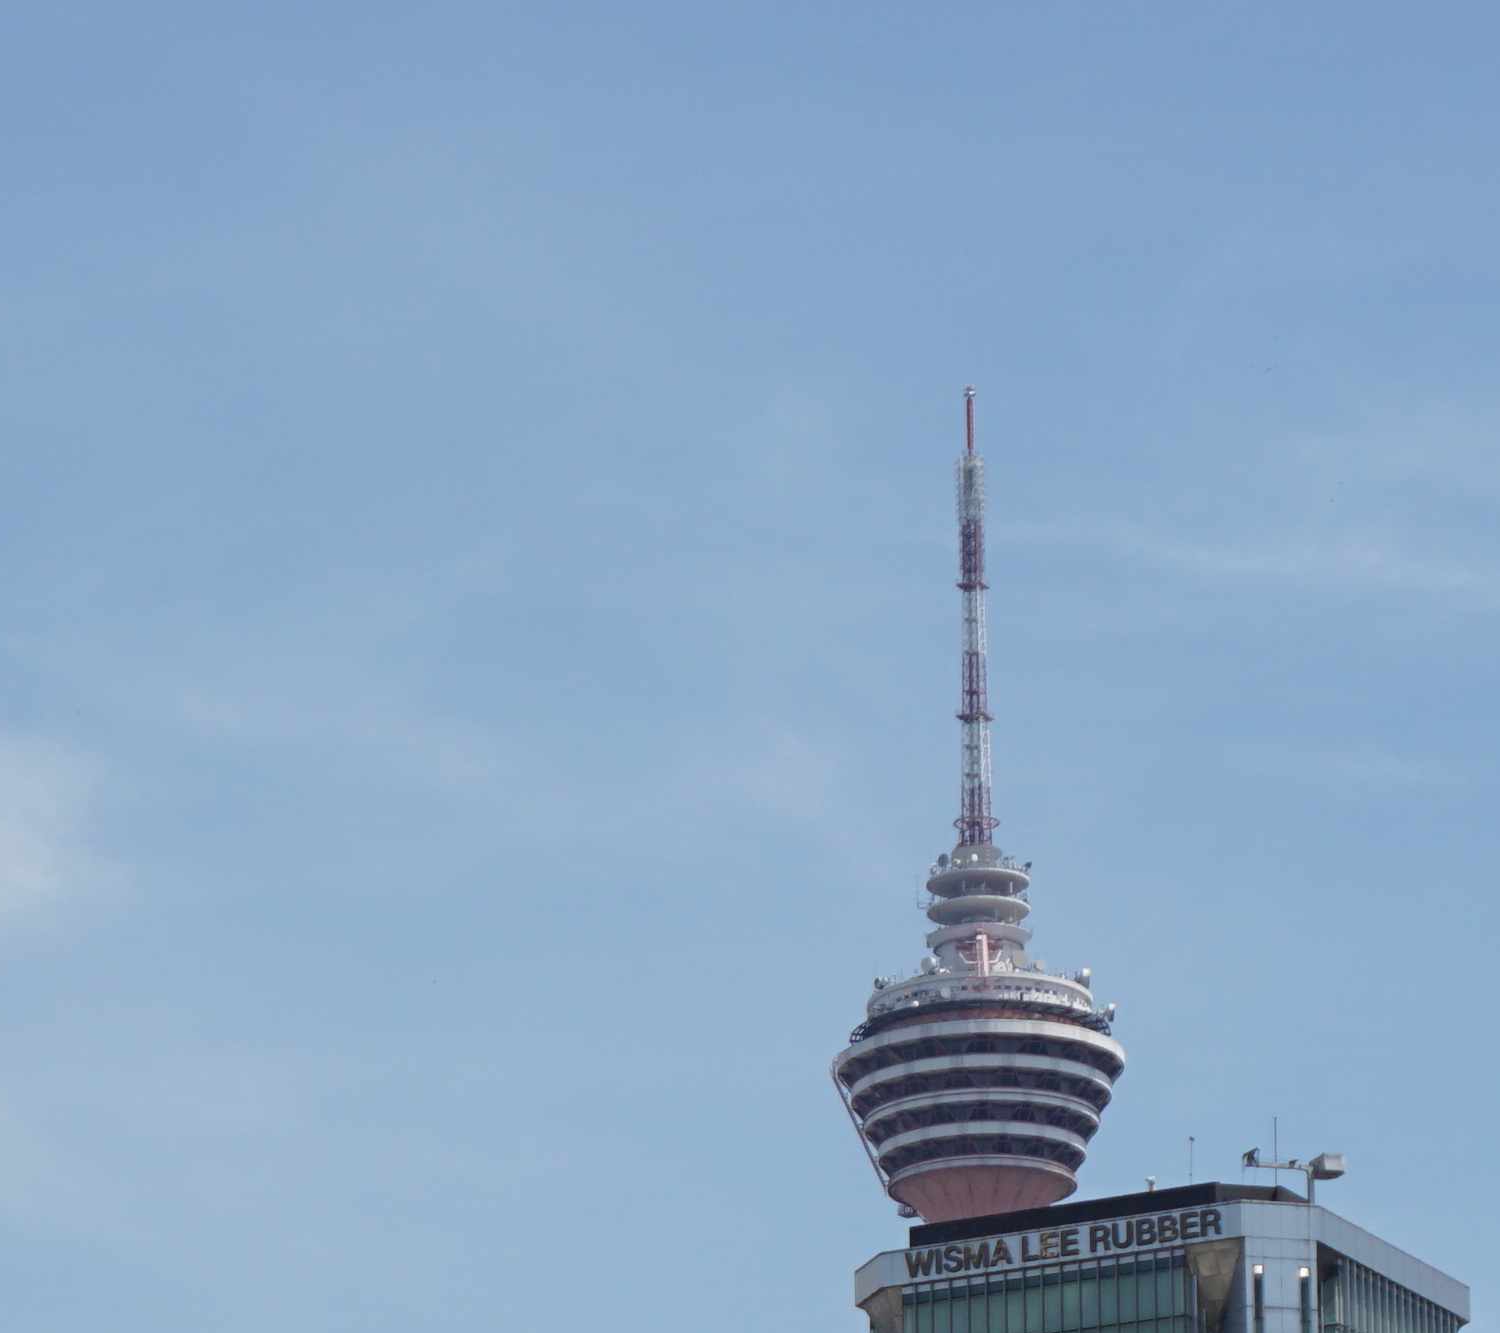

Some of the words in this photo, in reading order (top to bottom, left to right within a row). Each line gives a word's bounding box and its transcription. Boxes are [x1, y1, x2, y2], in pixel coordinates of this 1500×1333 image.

[904, 1238, 1012, 1278] WISMA
[1021, 1229, 1079, 1262] LEE
[1089, 1209, 1222, 1253] RUBBER
